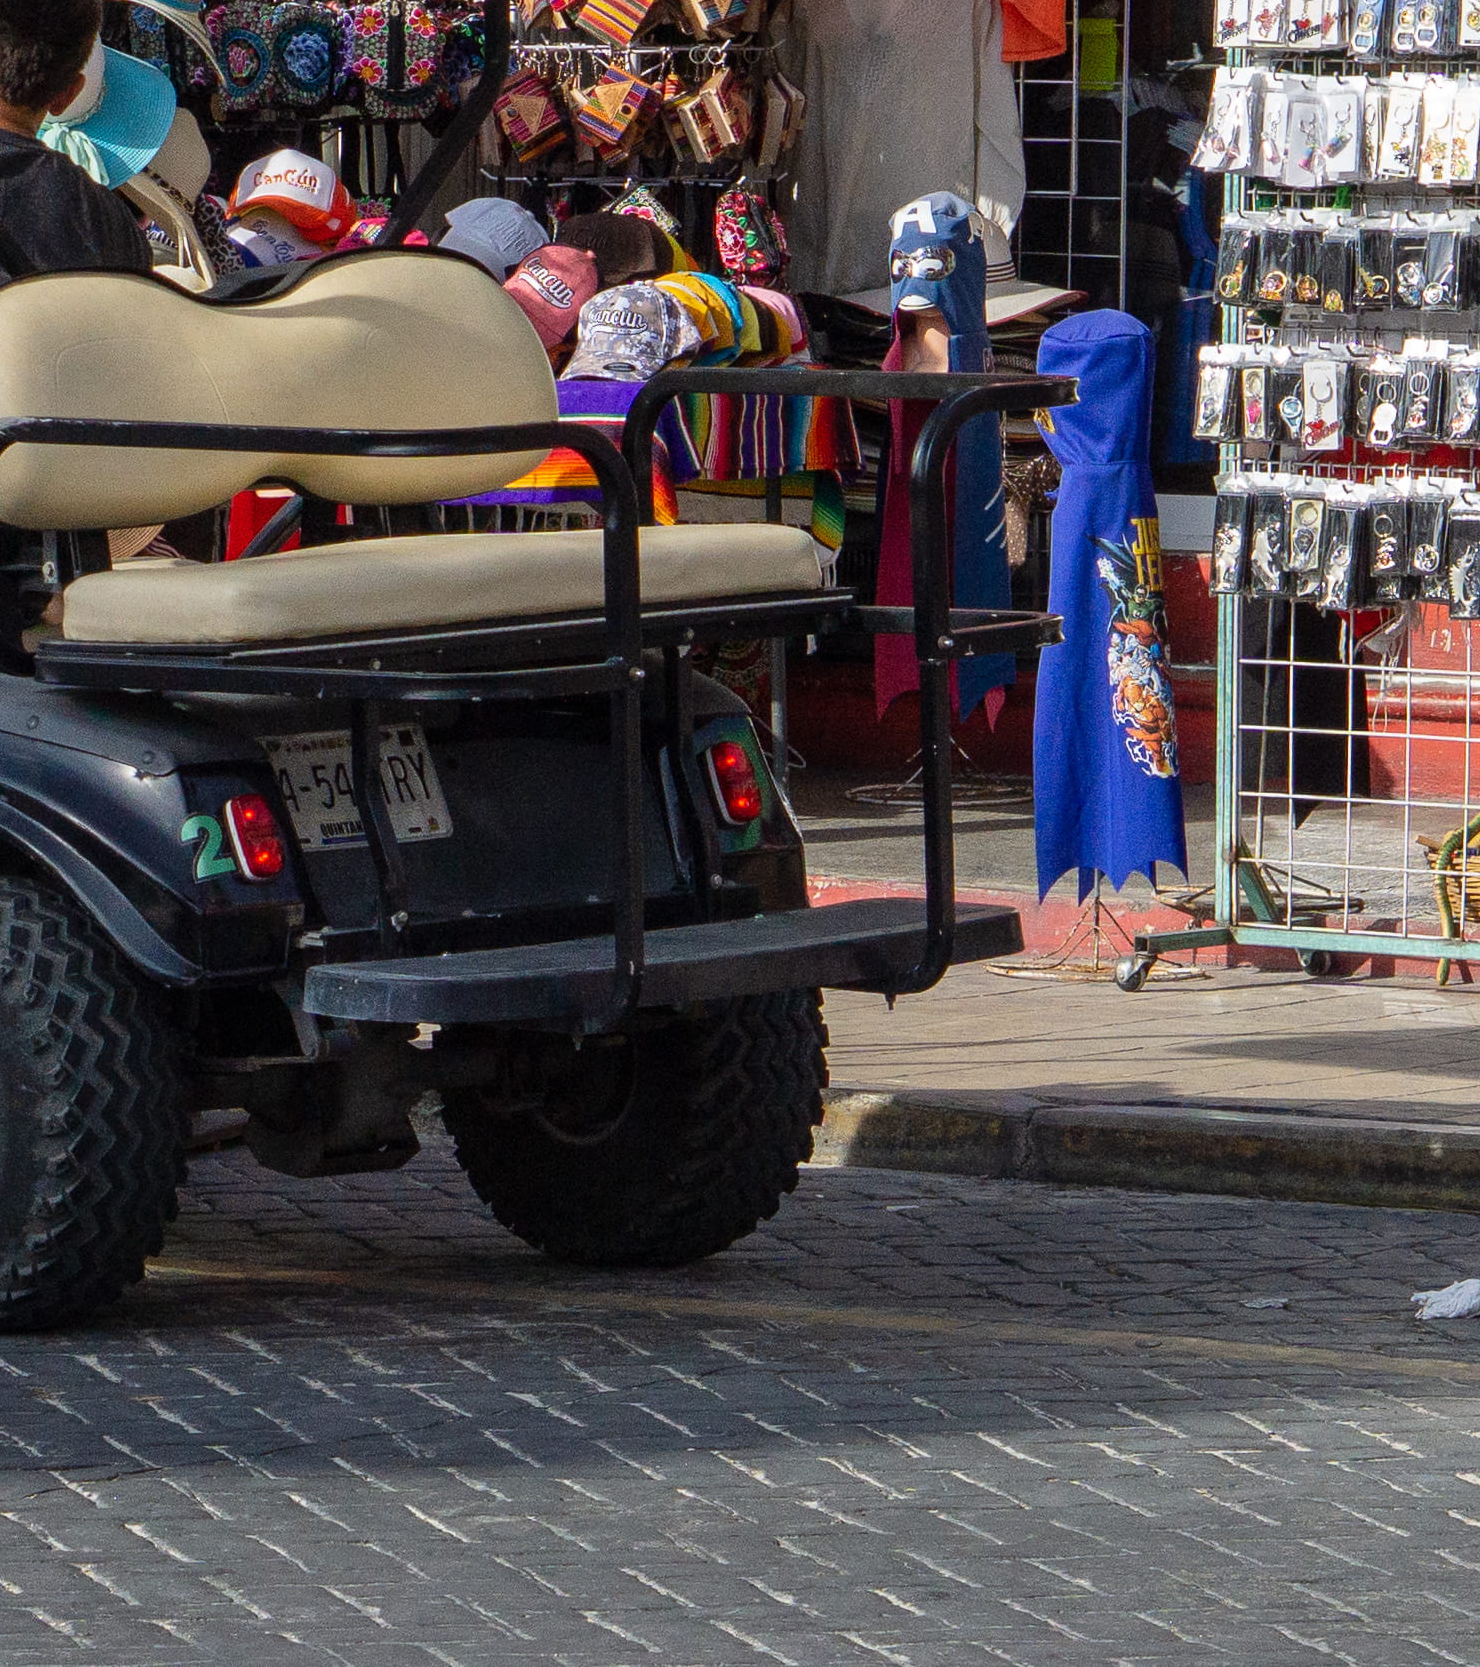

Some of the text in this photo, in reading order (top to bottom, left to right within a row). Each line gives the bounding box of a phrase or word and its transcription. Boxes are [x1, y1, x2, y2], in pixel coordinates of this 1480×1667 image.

[524, 256, 575, 306] Cancun
[588, 308, 649, 330] Cancun
[180, 813, 237, 880] 2
[319, 820, 365, 838] QUINTAN
